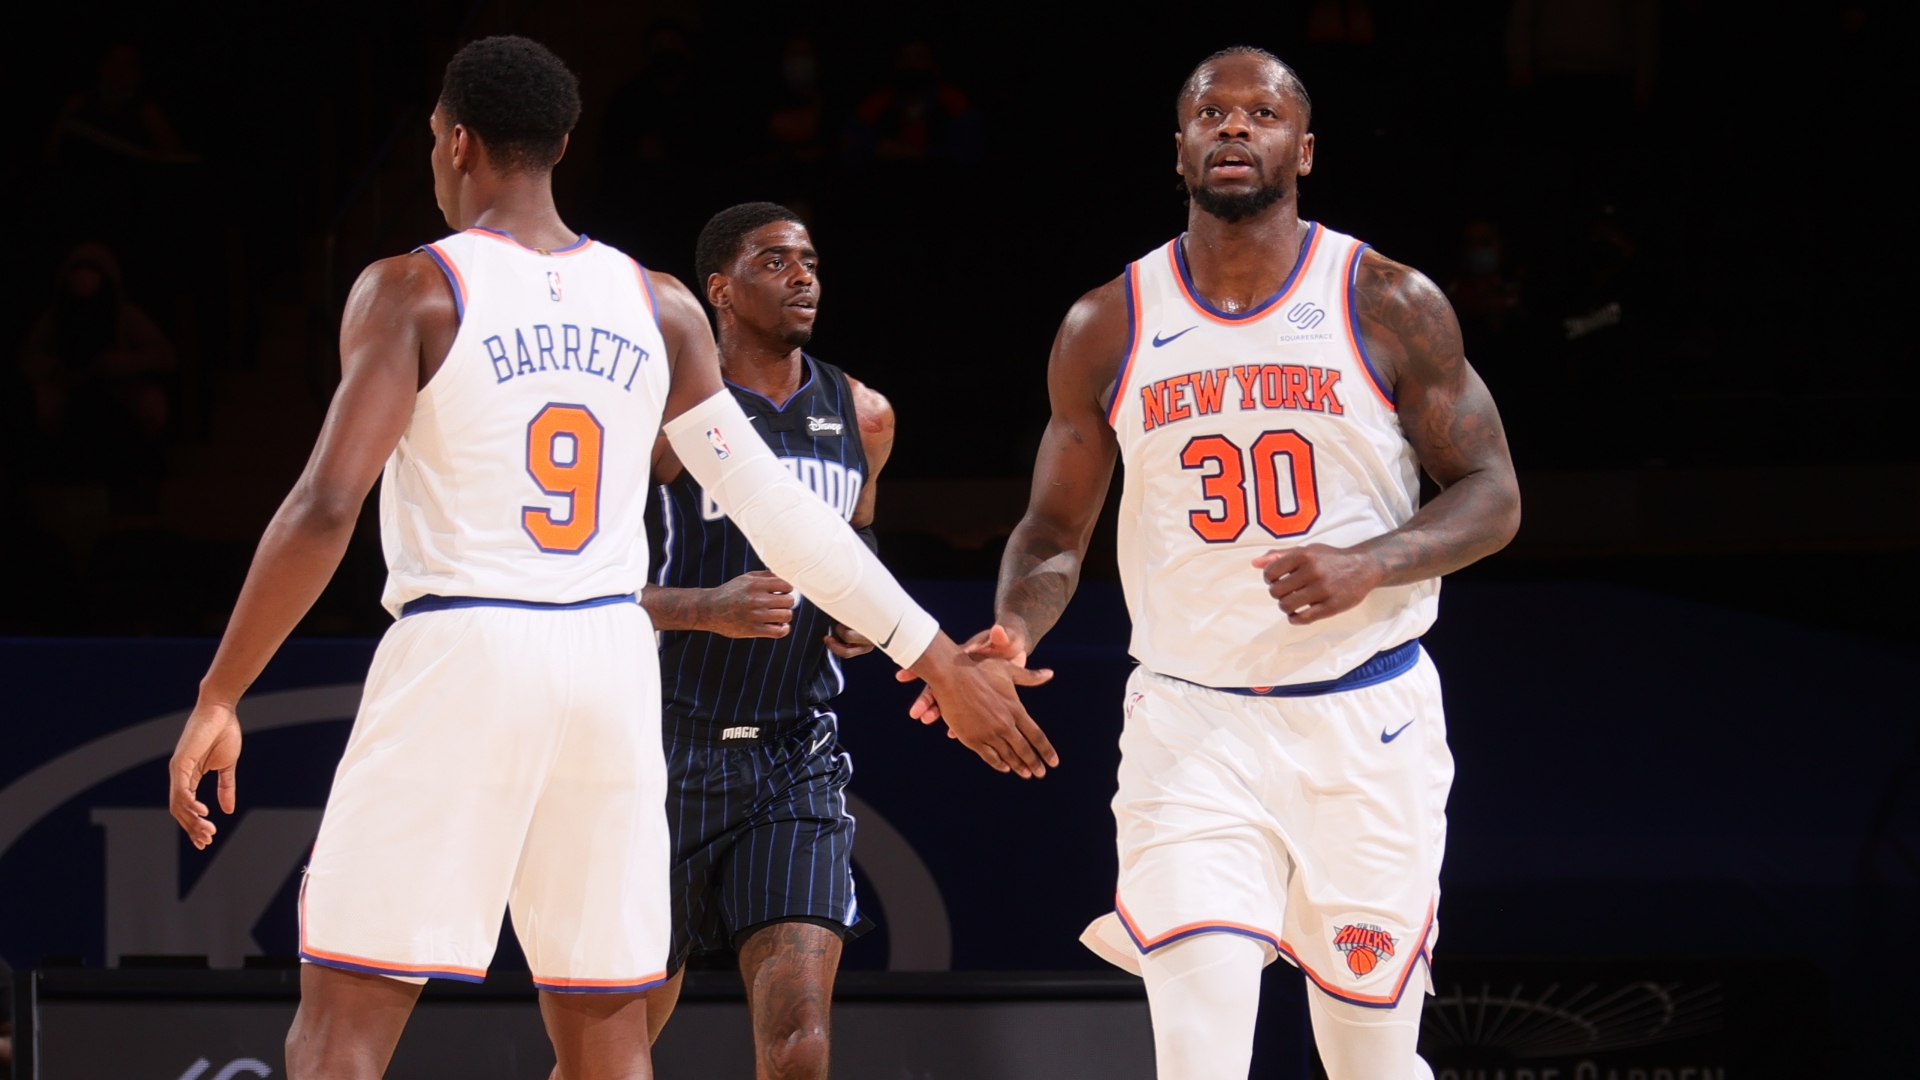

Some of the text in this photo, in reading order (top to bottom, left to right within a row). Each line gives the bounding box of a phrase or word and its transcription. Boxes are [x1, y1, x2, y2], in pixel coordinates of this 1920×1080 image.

[482, 324, 650, 392] BARRETT
[1280, 333, 1334, 342] SQUARESPACE
[1140, 363, 1345, 434] NEW YORK
[521, 402, 605, 556] 9
[1180, 428, 1321, 544] 30
[722, 726, 761, 741] MAGIC
[1333, 925, 1395, 957] KNICKS
